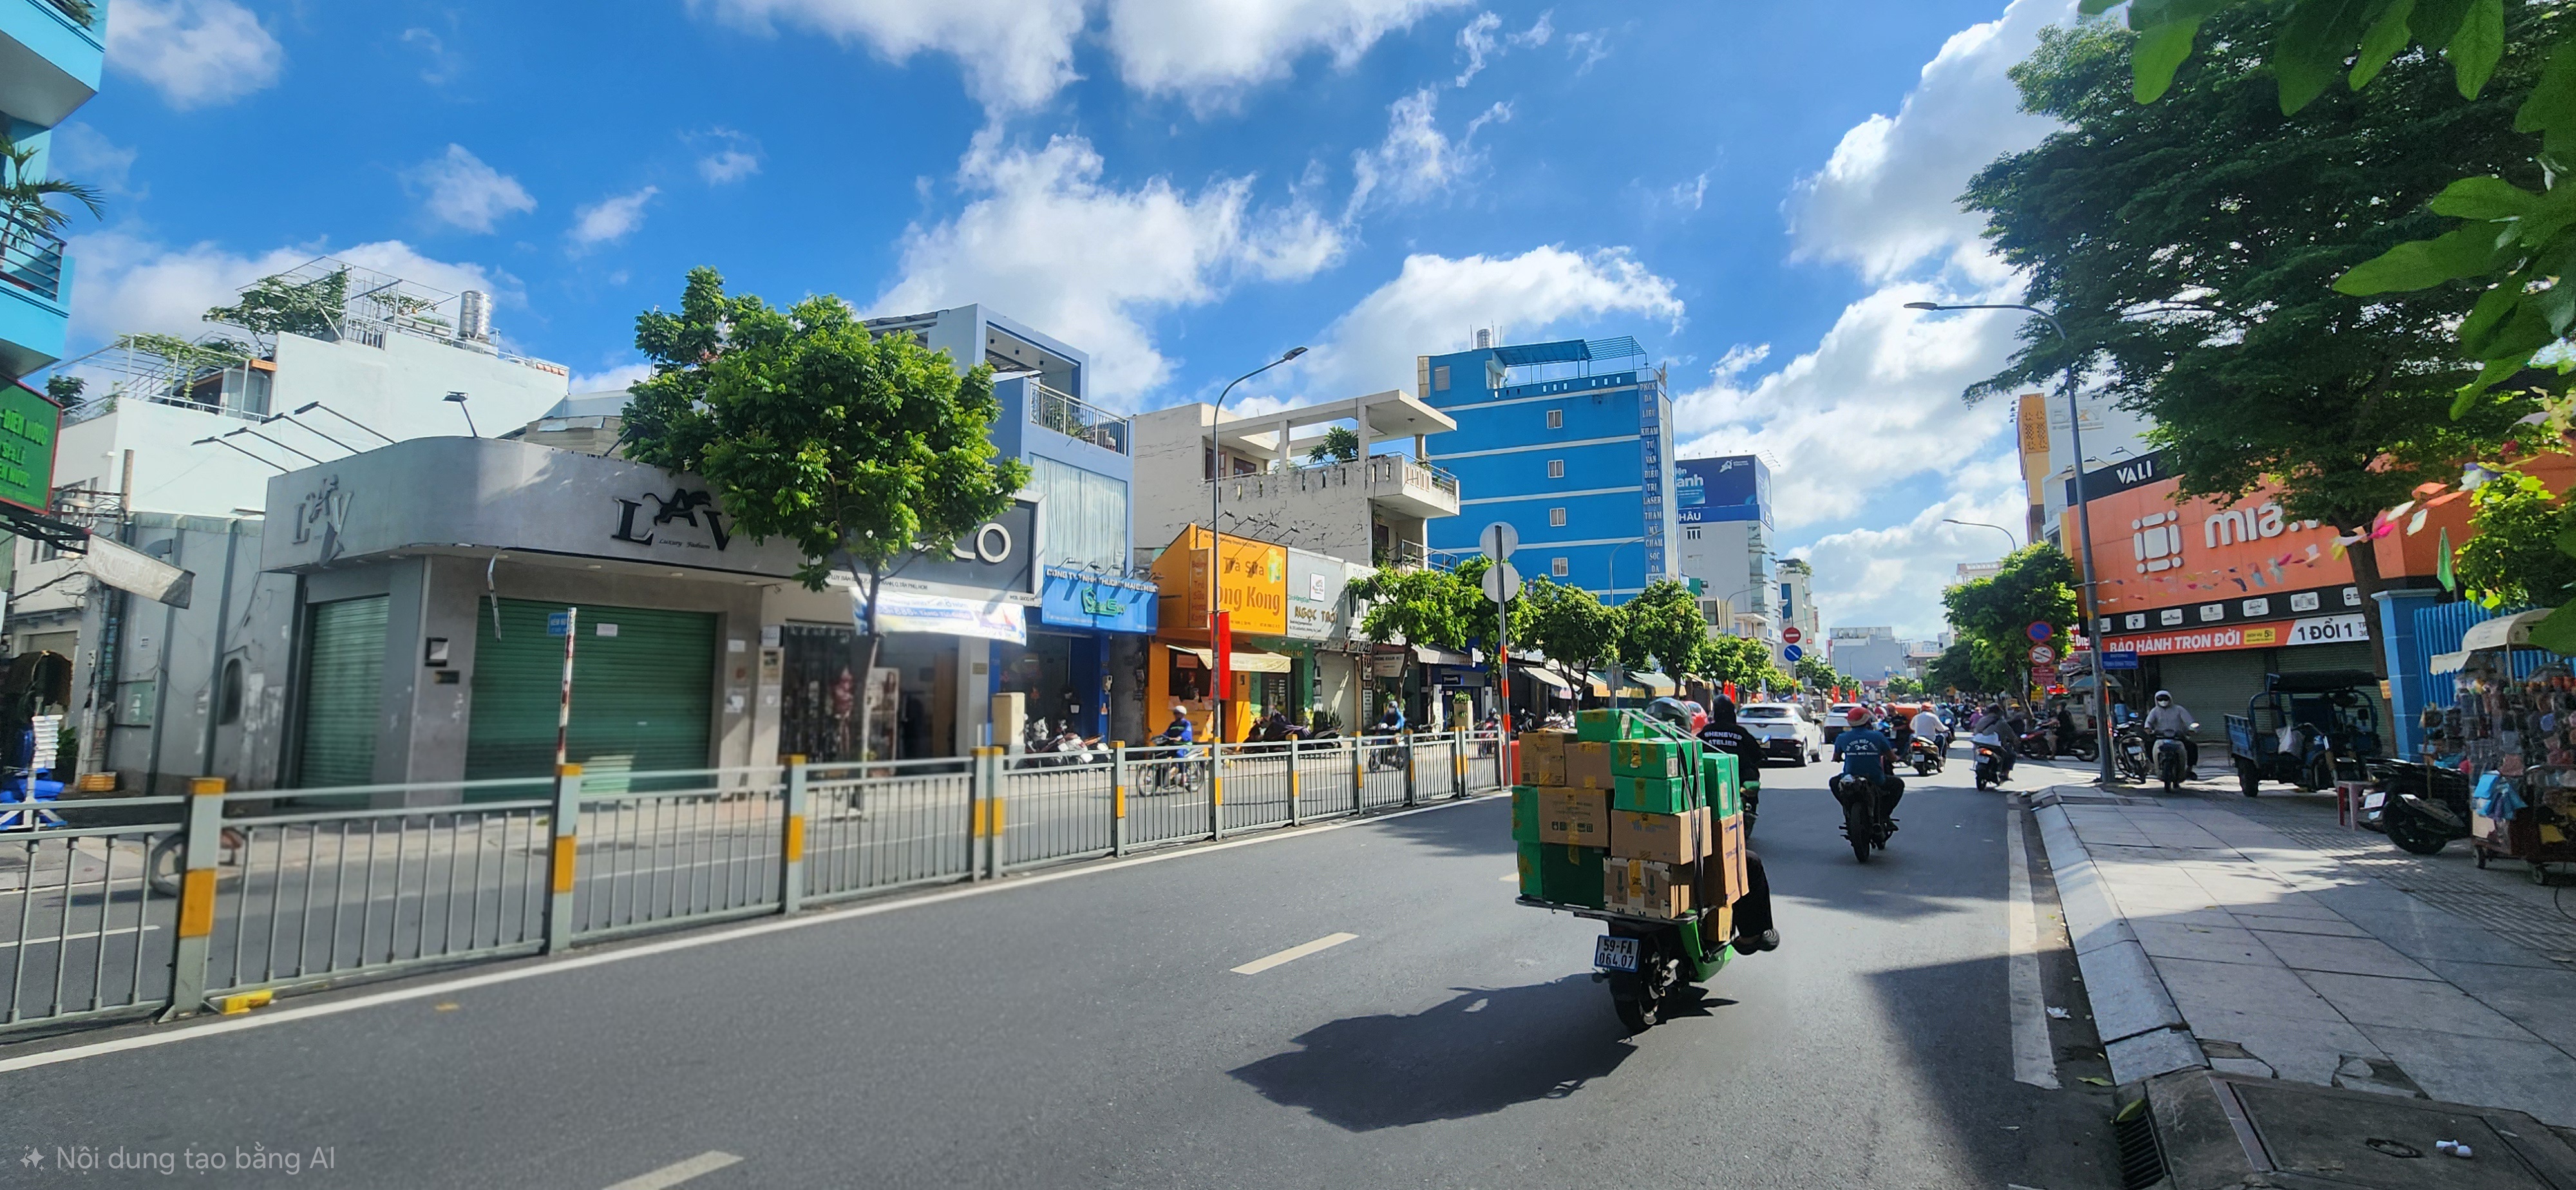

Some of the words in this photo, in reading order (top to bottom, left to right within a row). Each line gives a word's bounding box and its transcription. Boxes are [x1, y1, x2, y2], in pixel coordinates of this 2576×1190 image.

[1641, 426, 1658, 436] KHÁM
[1676, 474, 1703, 487] anh
[2116, 460, 2152, 484] VALI
[1678, 511, 1701, 522] HÂU
[2204, 502, 2320, 548] mia.
[1218, 586, 1242, 612] ong
[1247, 586, 1280, 616] Kong
[1294, 605, 1317, 623] NGỌC
[2298, 627, 2306, 641] 1
[2310, 618, 2340, 640] ĐỔI
[2344, 623, 2353, 638] 1
[2110, 638, 2134, 652] BẢO
[2136, 636, 2172, 652] HÀNH
[2174, 634, 2211, 650] TRỌN
[2214, 628, 2240, 647] ĐỜI
[1604, 939, 1632, 954] 59-FA
[1600, 952, 1634, 968] 064.07
